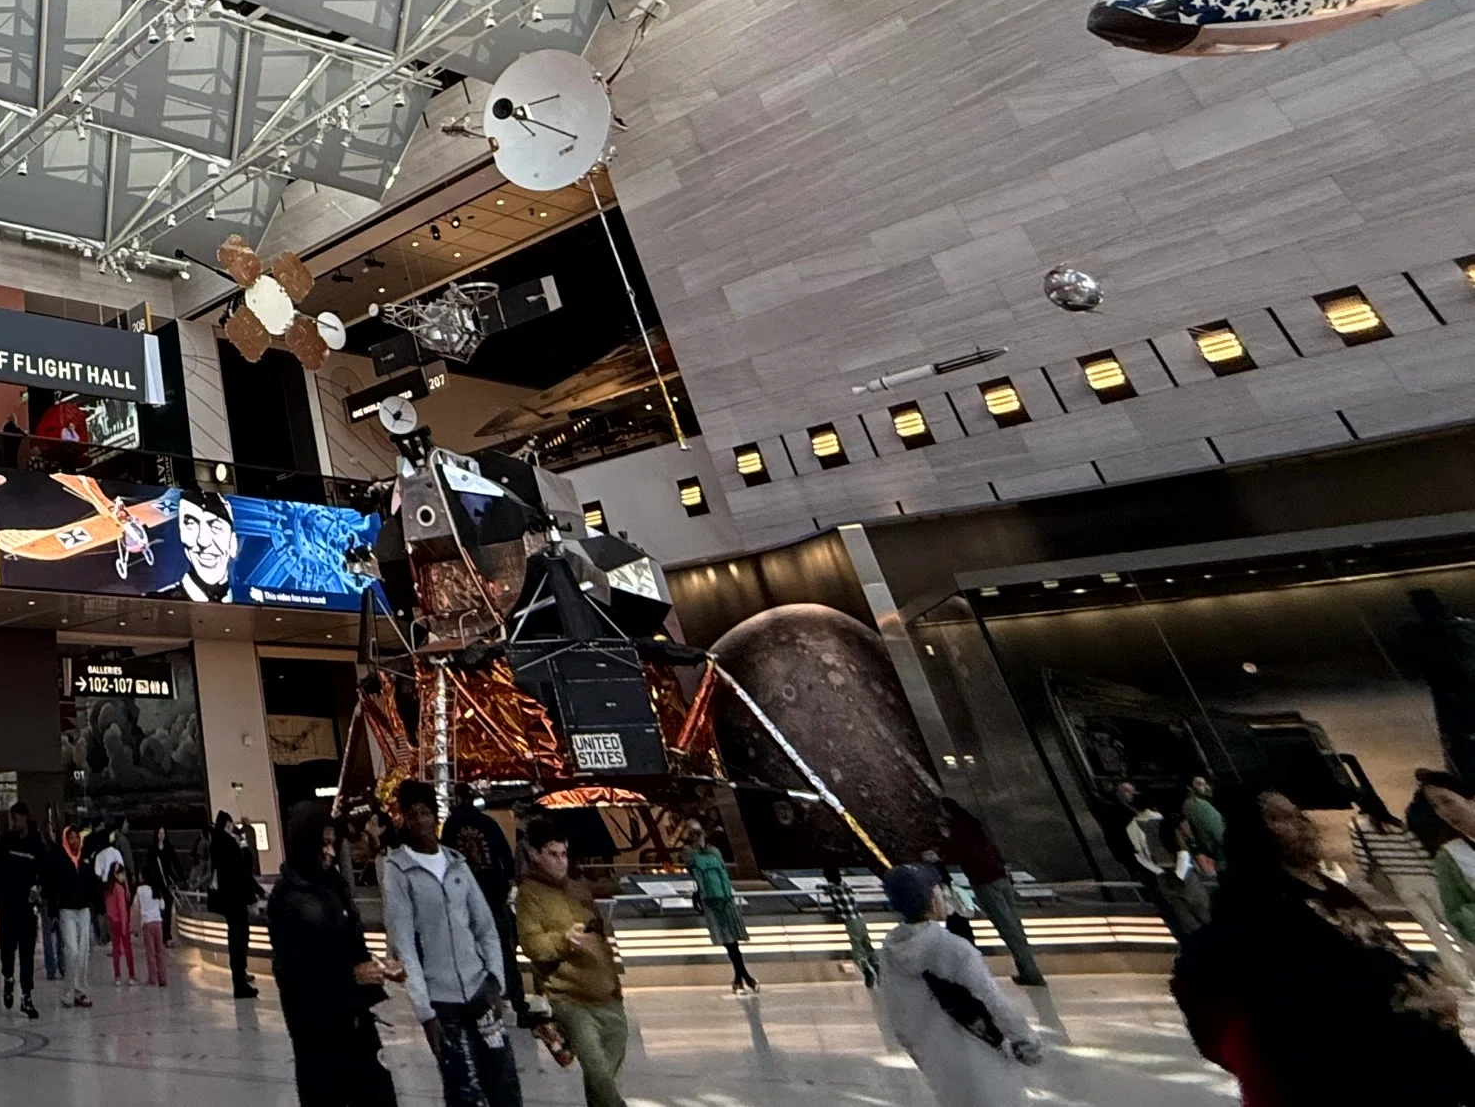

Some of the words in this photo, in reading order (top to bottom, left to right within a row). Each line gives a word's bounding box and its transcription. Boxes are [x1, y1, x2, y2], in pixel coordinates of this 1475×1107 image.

[13, 353, 83, 382] FLIGHT
[87, 365, 137, 390] HALL
[428, 374, 445, 390] 207
[87, 665, 123, 675] GALLERIES
[88, 677, 133, 693] 102-107
[574, 736, 620, 750] UNITED
[578, 752, 624, 765] STATES
